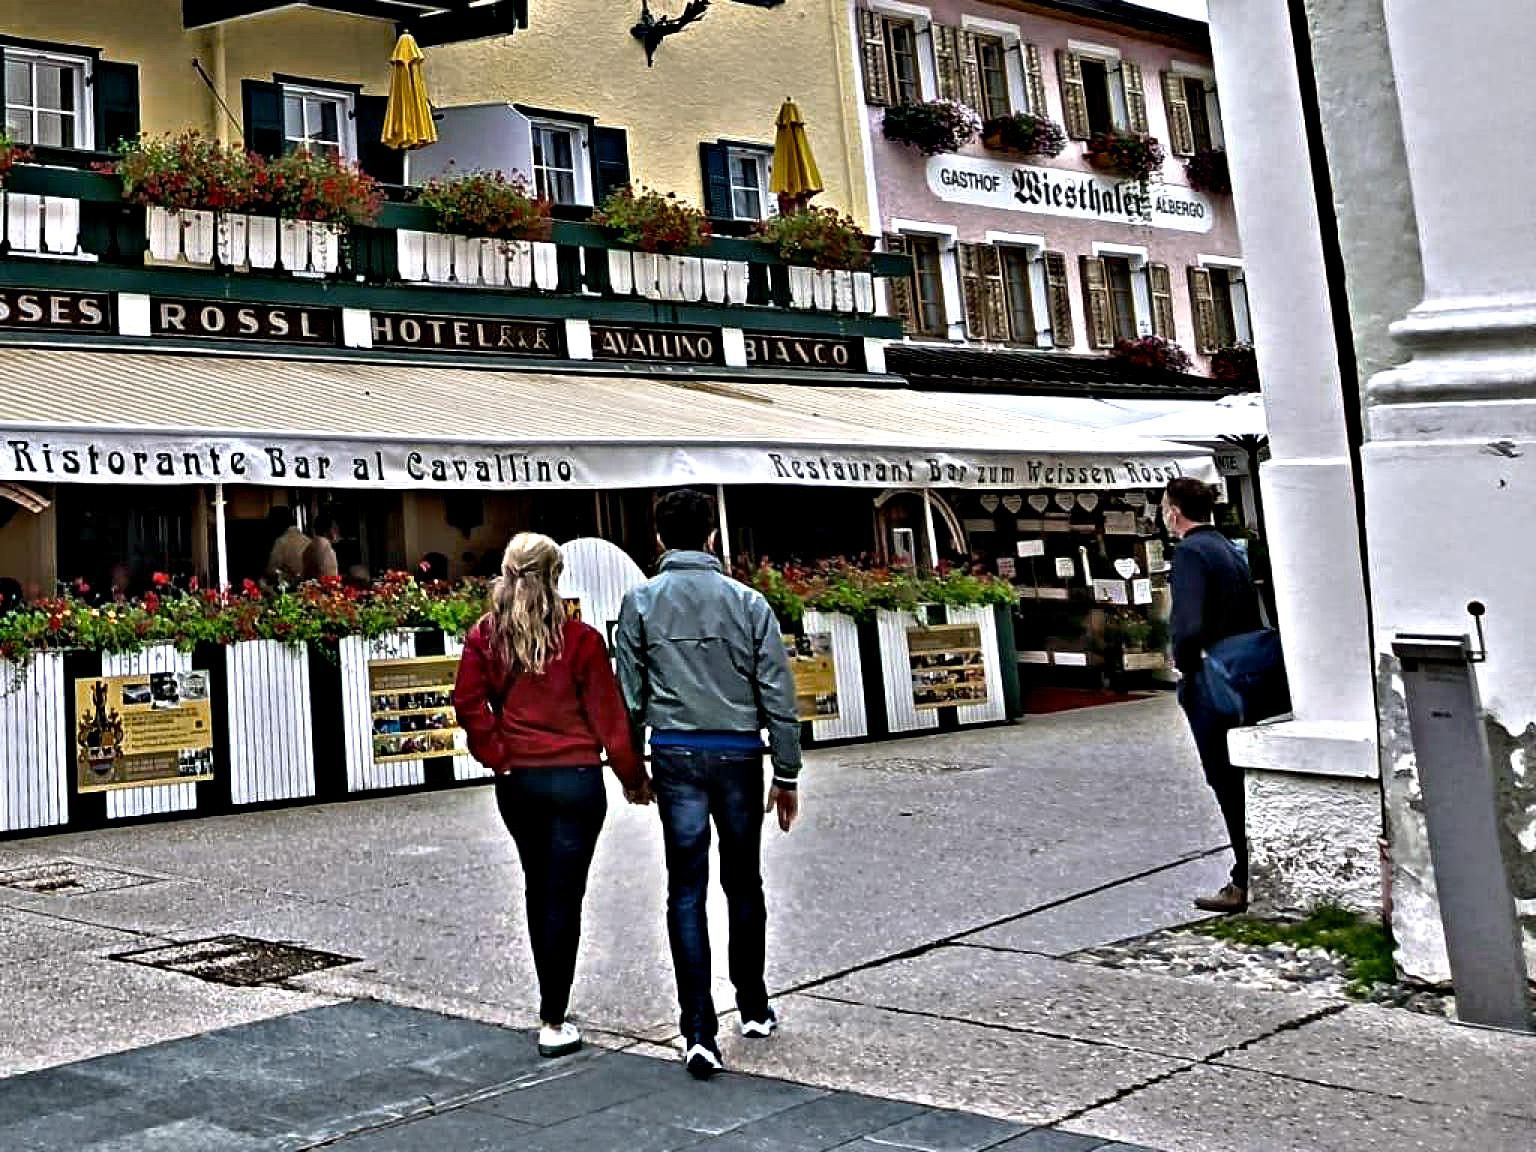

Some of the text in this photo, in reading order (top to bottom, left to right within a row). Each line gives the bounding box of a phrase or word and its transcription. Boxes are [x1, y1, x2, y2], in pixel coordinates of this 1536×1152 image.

[941, 168, 1000, 193] GASTHOF
[1155, 196, 1204, 219] ALBERGO
[159, 302, 320, 338] ROSSL
[371, 316, 493, 347] HOTEL
[591, 331, 713, 359] AVALLINO
[745, 339, 849, 365] BIANCO
[8, 440, 575, 483] Ristorante Bar al Cavallino
[767, 453, 914, 482] Restaurant
[927, 458, 966, 483] Bar
[977, 464, 1015, 484] zum
[1027, 460, 1116, 485] Weissen
